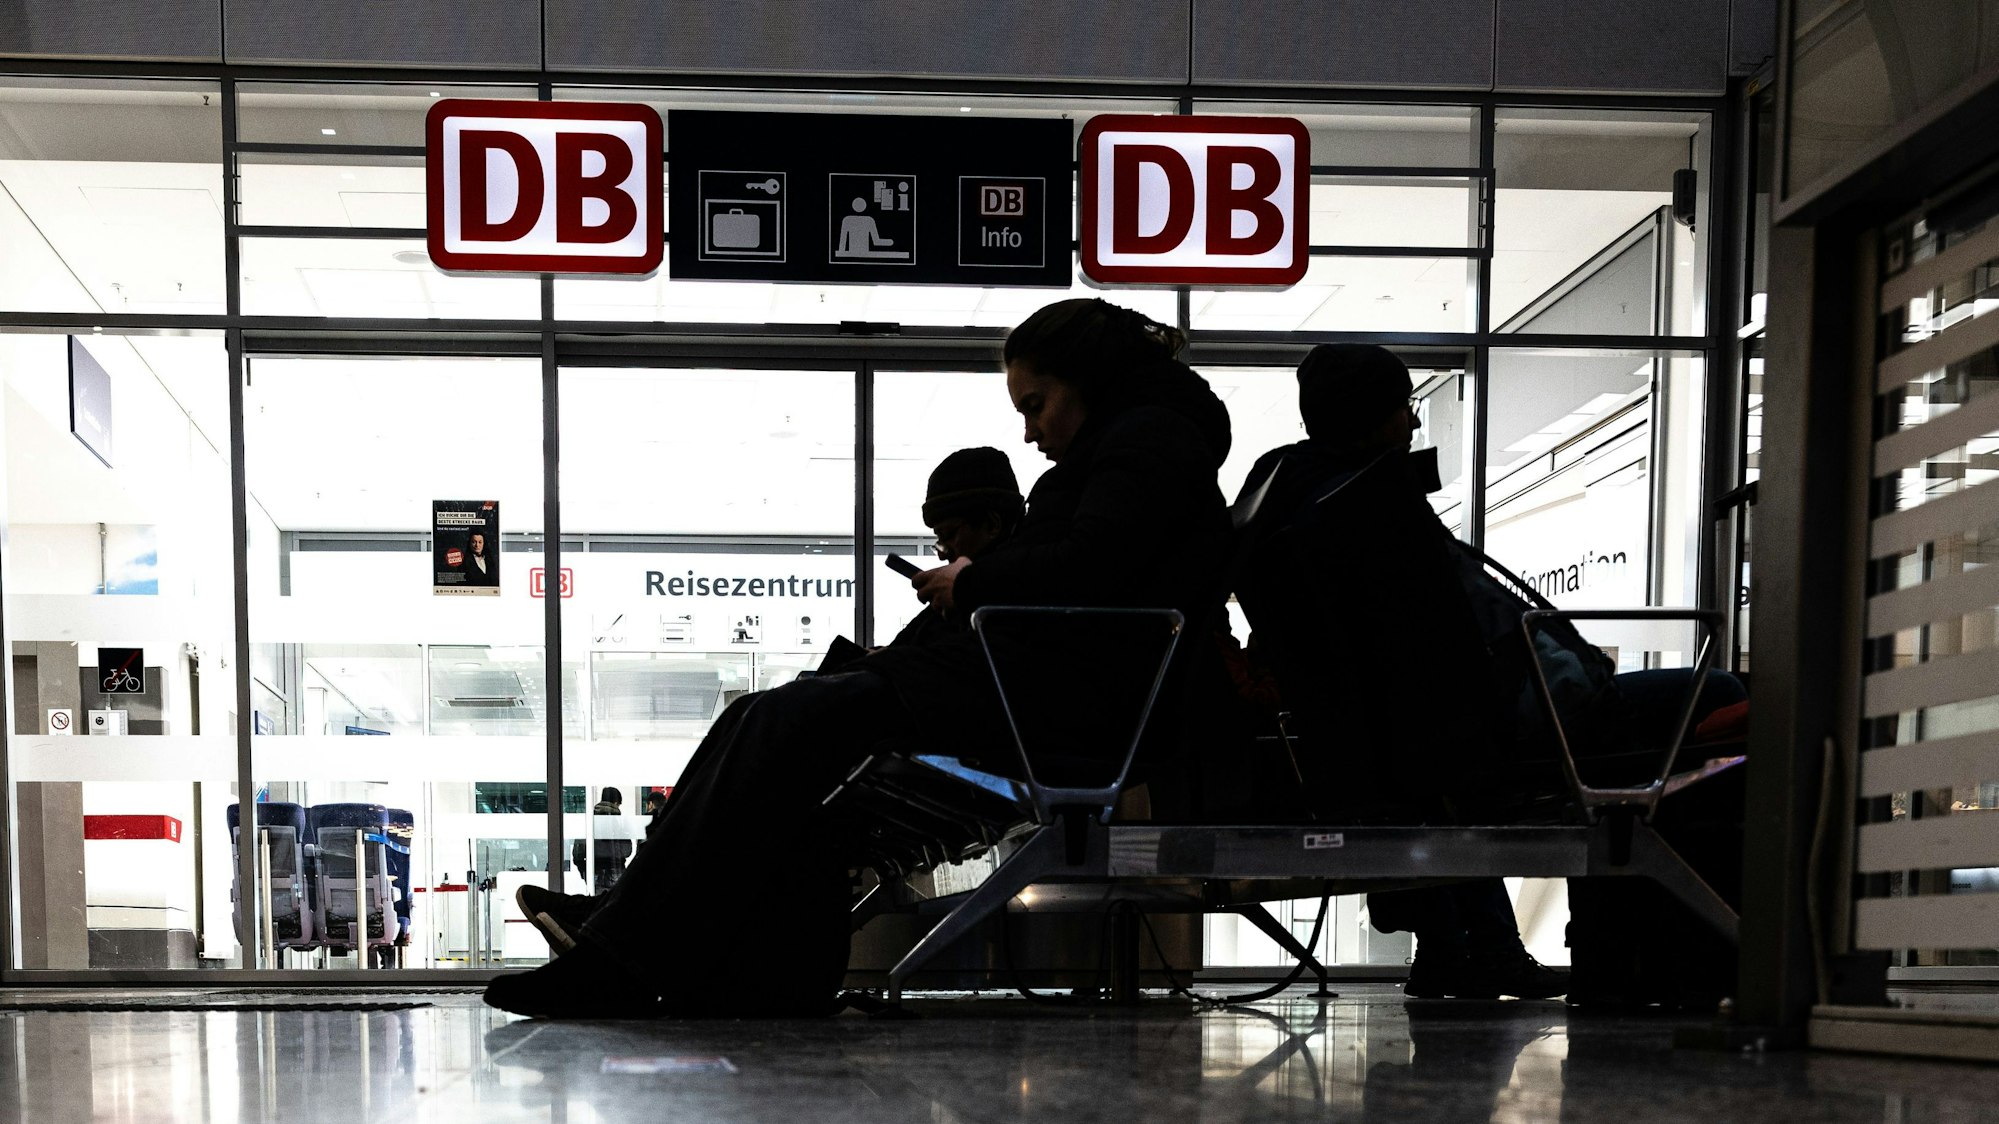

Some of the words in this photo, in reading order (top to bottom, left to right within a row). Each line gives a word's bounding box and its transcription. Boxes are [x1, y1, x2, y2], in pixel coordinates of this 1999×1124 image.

[460, 130, 637, 243] DB
[984, 188, 1022, 213] DB
[1113, 144, 1284, 255] DB
[981, 226, 1022, 248] Info
[646, 570, 856, 598] Reisezentrum
